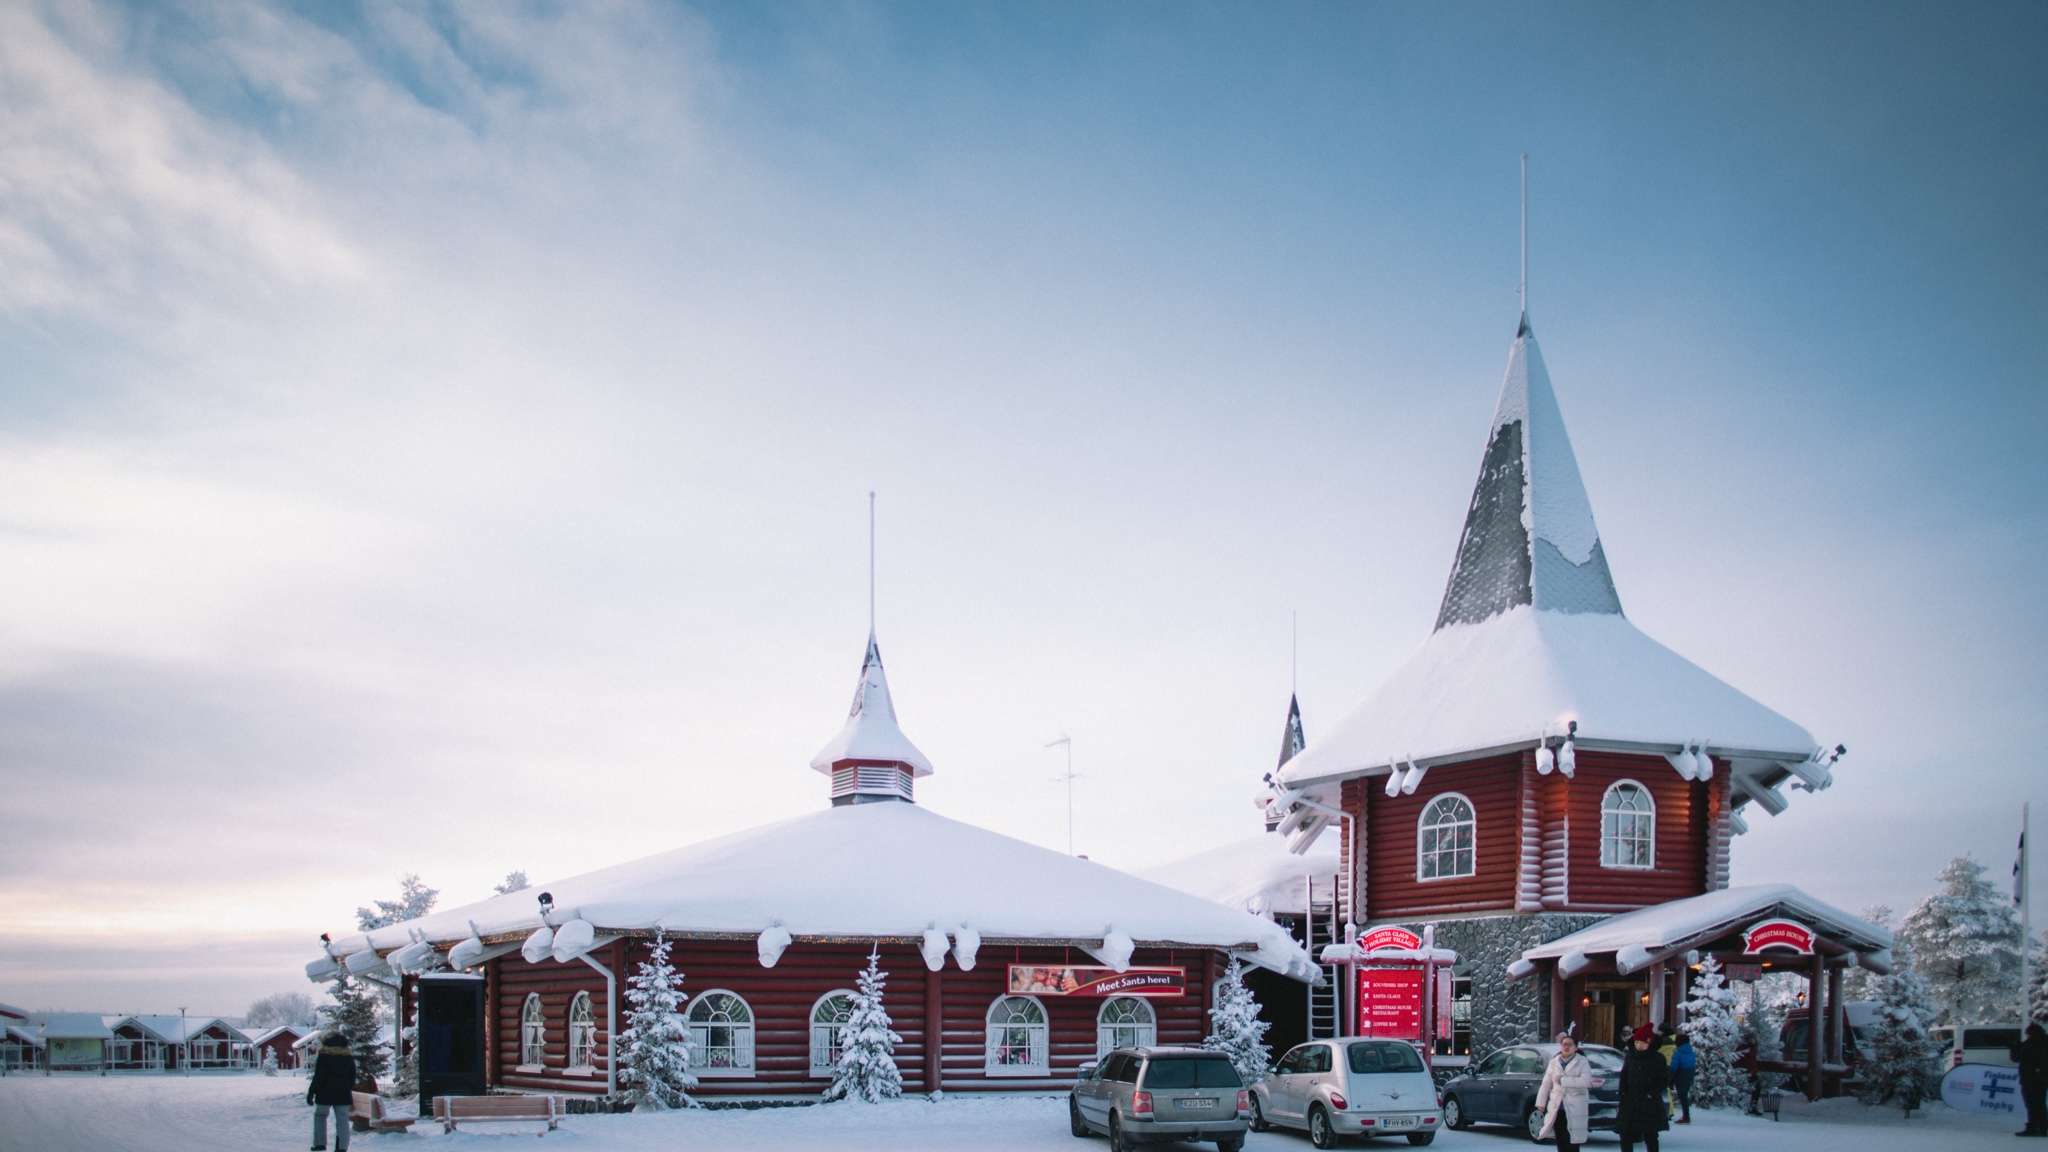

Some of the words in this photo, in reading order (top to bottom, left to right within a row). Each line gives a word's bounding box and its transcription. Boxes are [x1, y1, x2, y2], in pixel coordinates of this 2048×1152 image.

[1374, 931, 1391, 939] SANTA
[1392, 931, 1409, 940] CLAUS
[1753, 930, 1785, 942] CHRISTMAS
[1786, 930, 1805, 943] HOUSE
[1393, 937, 1414, 948] VILLAGE
[1727, 965, 1761, 979] OPEN
[1096, 980, 1120, 993] Meet
[1121, 976, 1146, 987] Santa
[1147, 975, 1170, 984] here!
[1980, 1099, 2014, 1112] trophy
